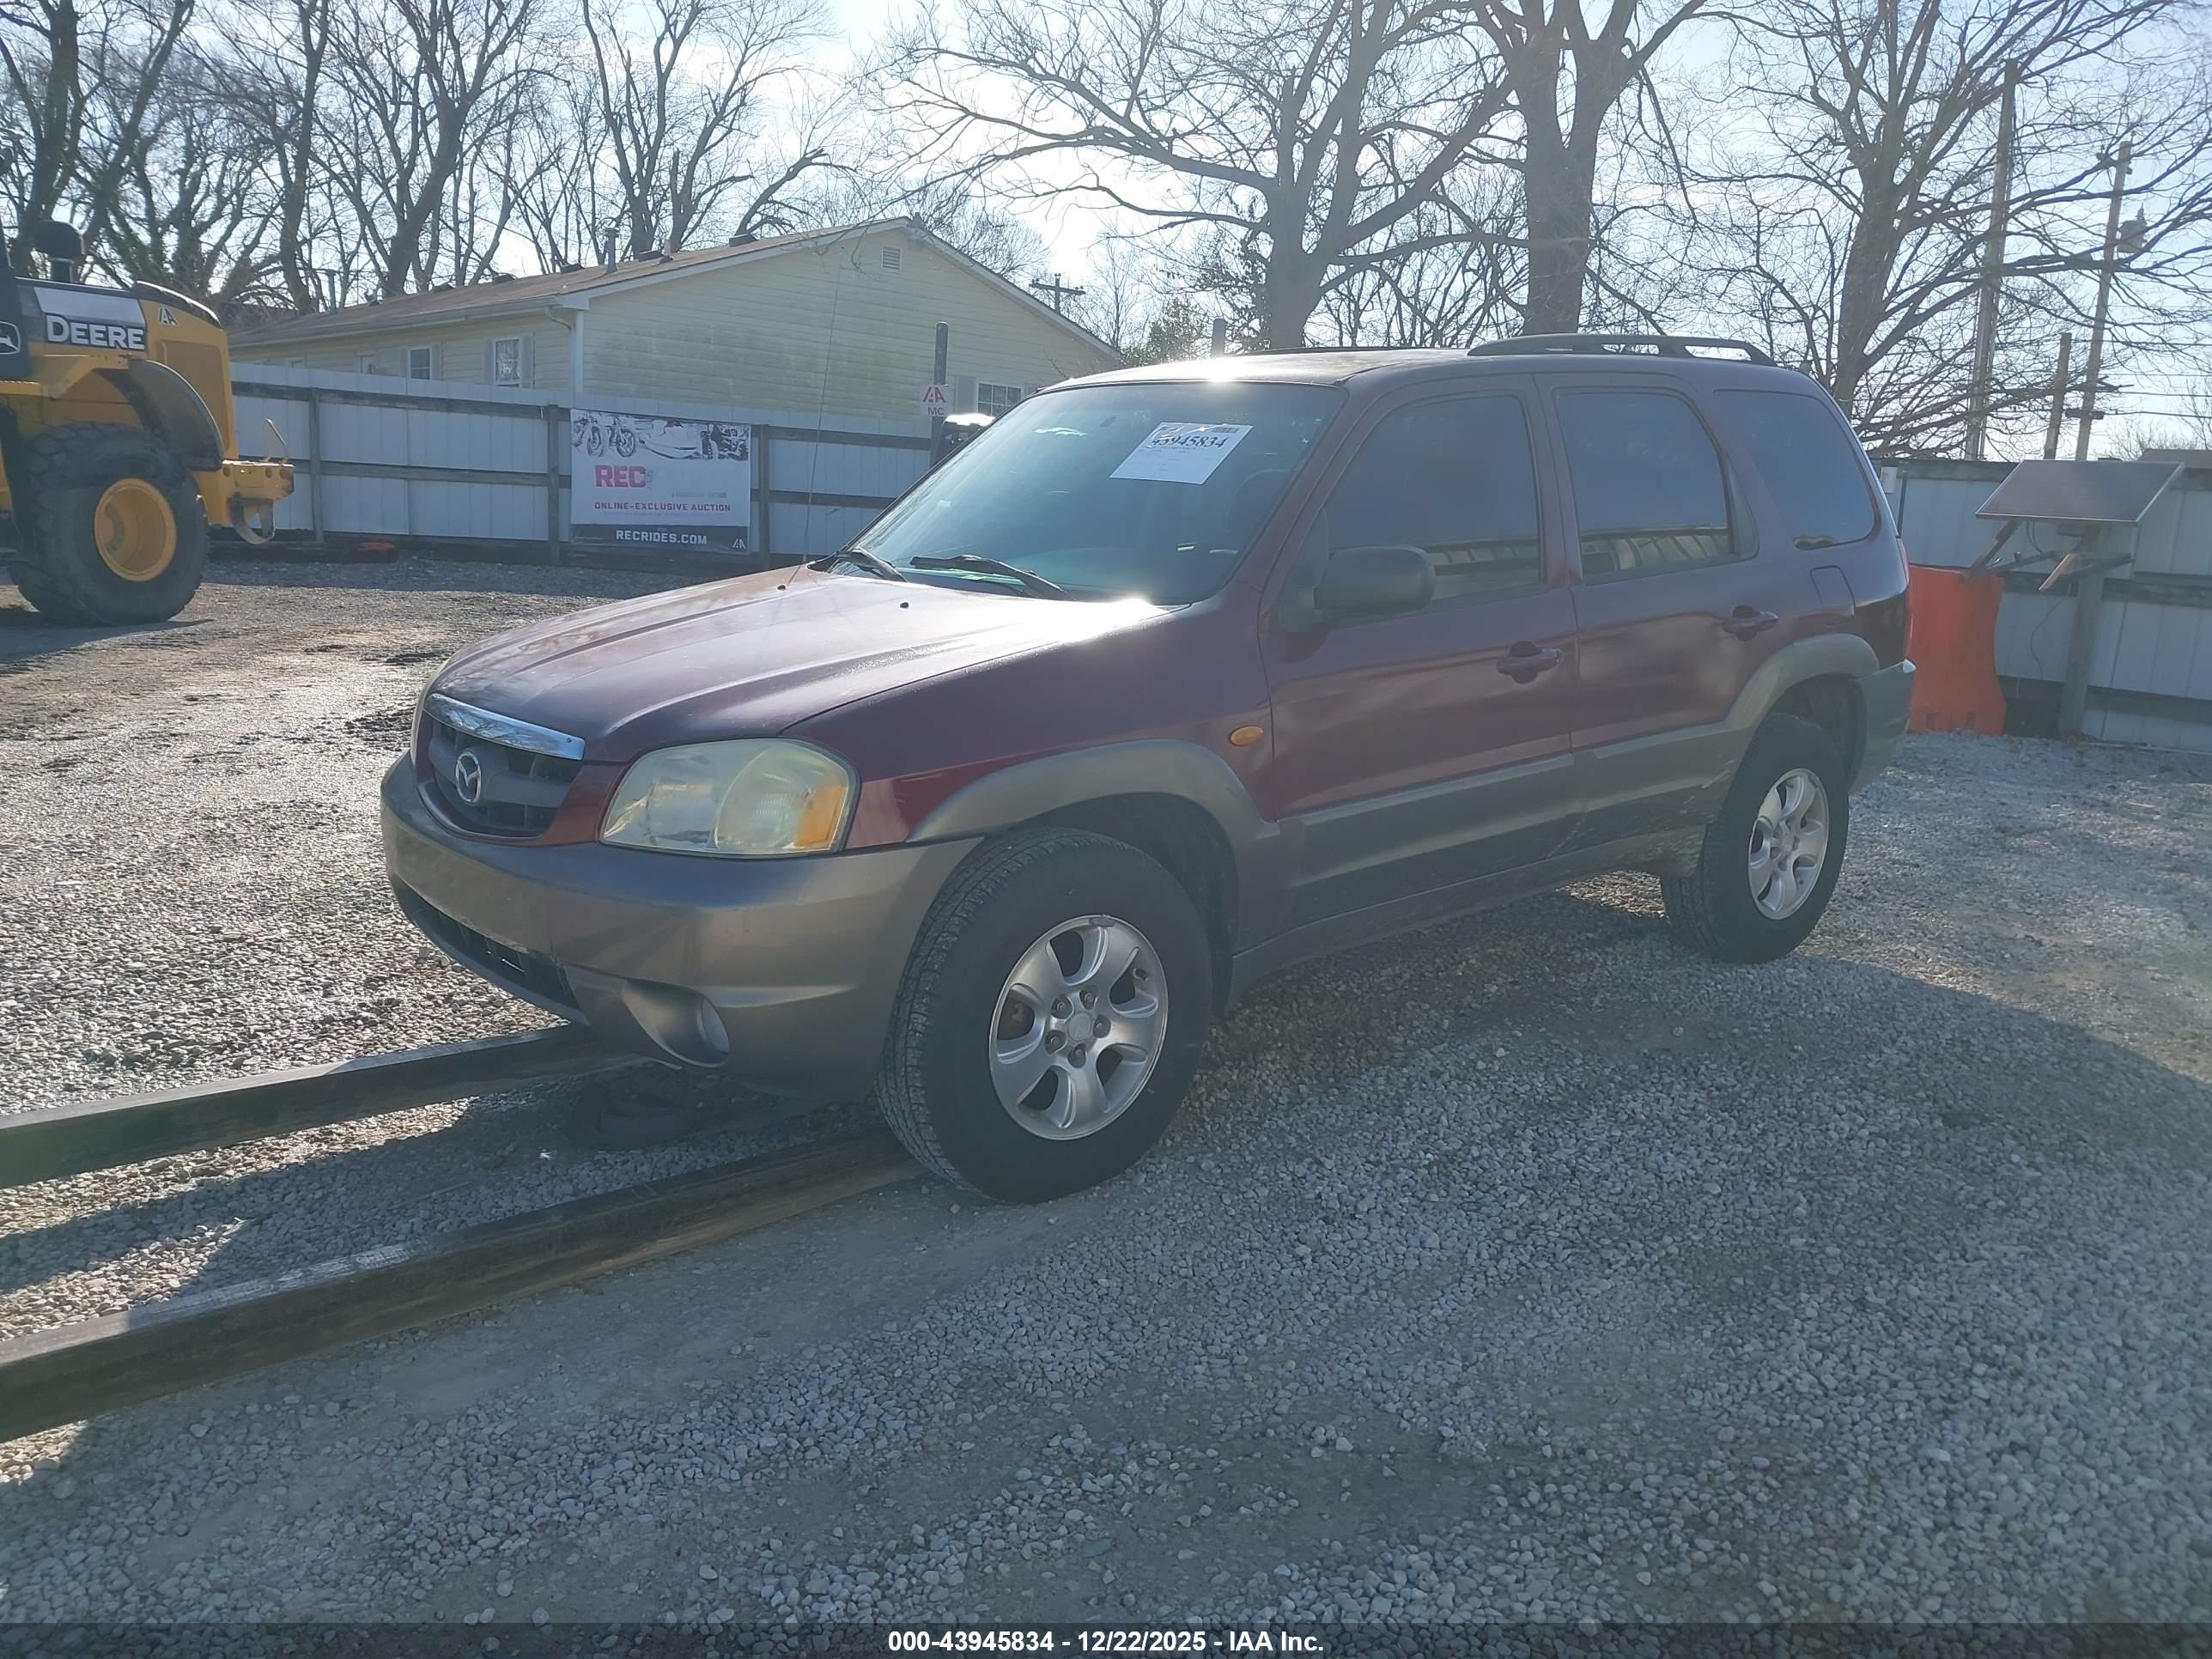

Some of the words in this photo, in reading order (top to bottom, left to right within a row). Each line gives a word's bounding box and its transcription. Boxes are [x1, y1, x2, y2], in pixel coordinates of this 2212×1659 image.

[46, 314, 145, 350] DEERE
[927, 406, 945, 416] MC
[594, 501, 688, 511] ONLINE-EXCLUSIVE
[690, 503, 732, 512] AUCTION
[616, 529, 708, 545] RECRIDES.COM
